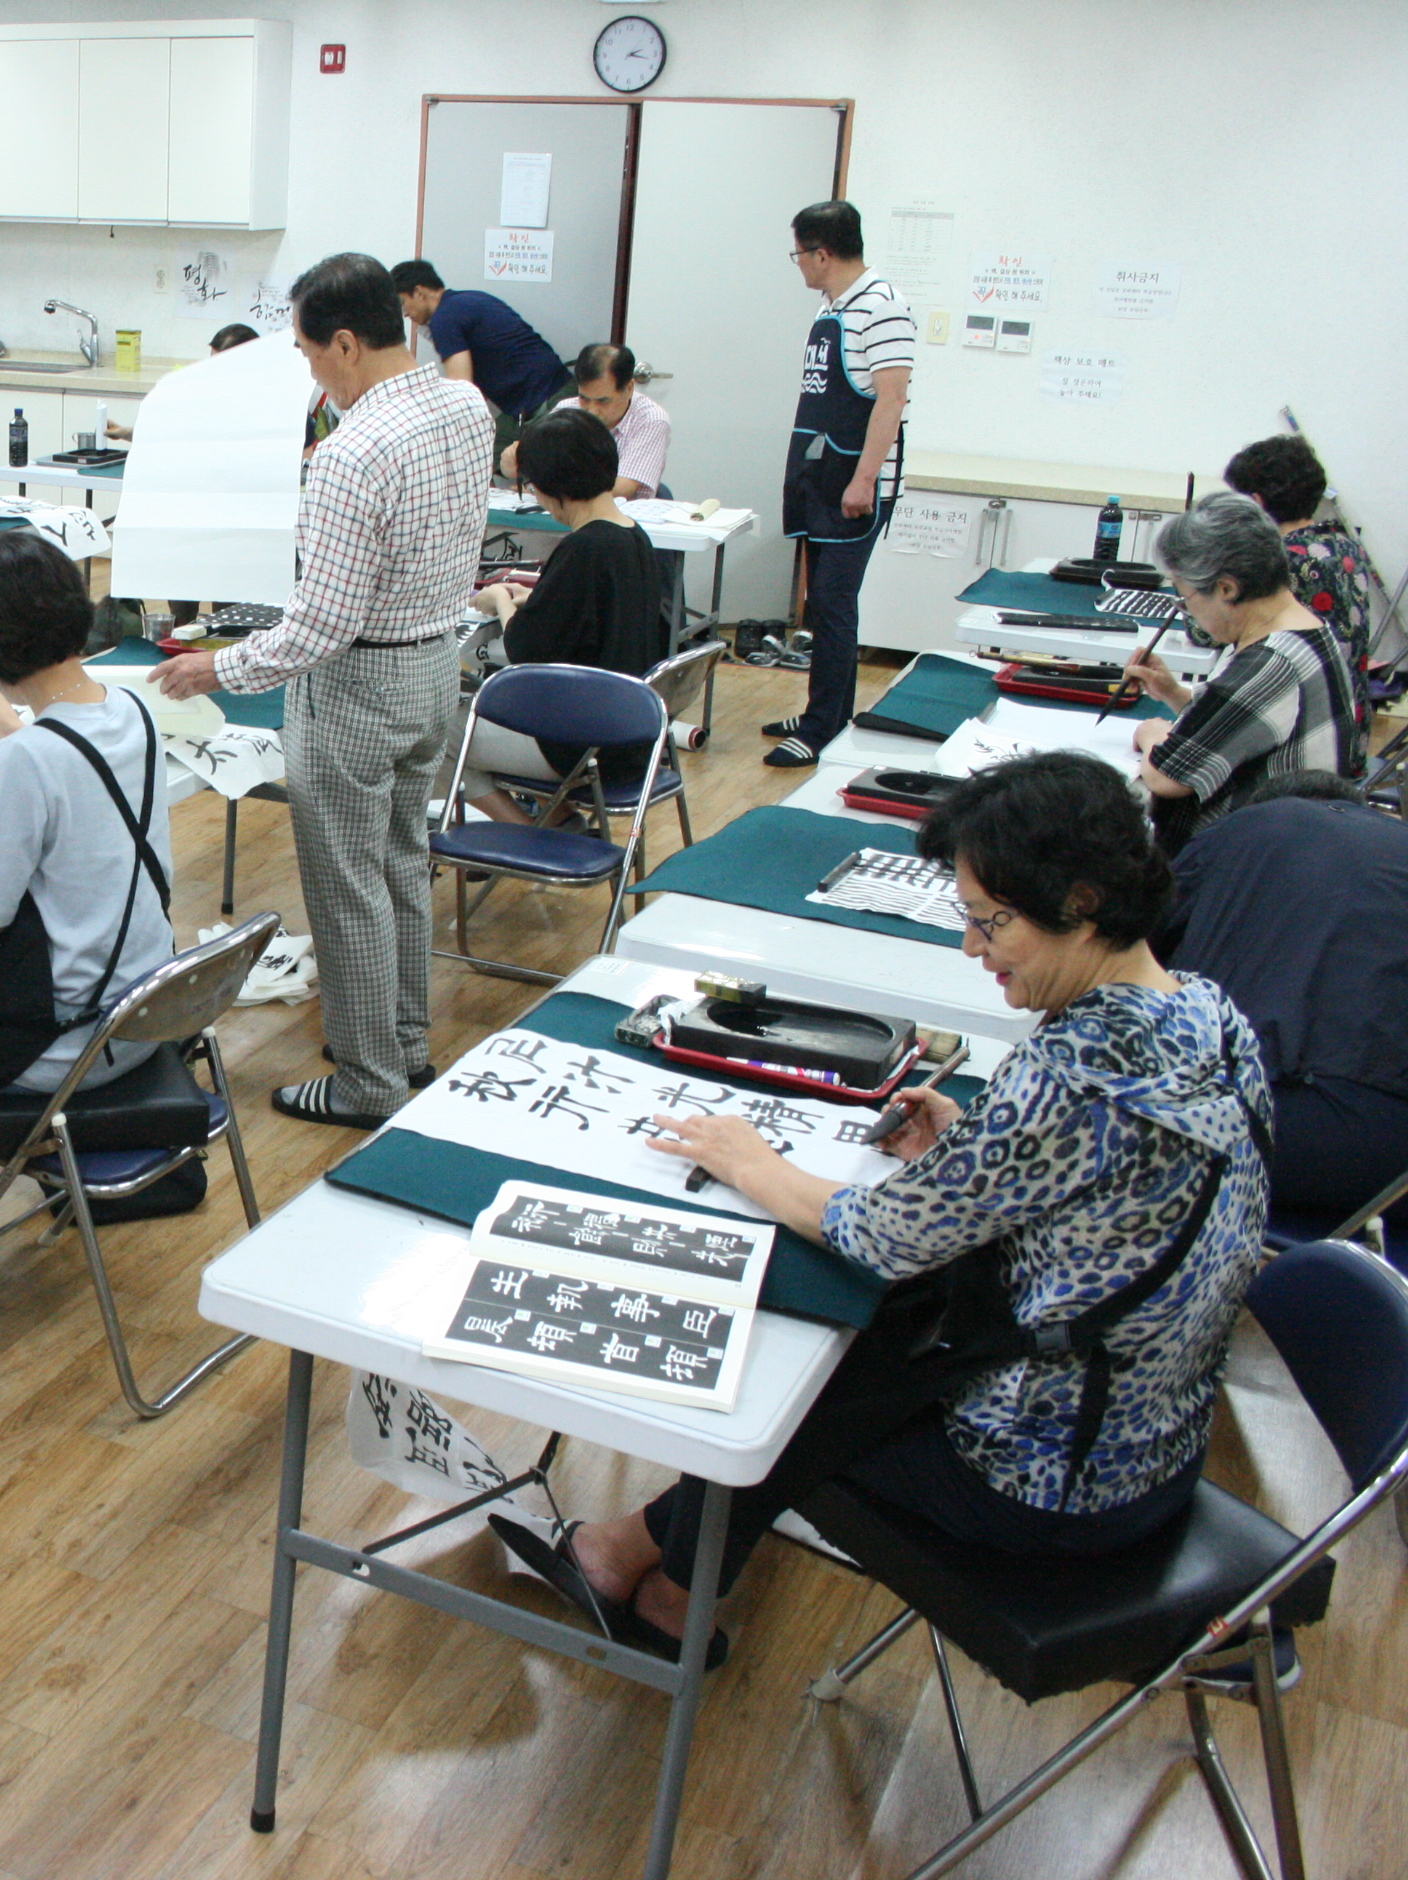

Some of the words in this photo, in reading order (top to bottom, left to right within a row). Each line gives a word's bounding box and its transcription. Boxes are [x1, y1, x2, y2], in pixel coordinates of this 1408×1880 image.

[182, 264, 228, 302] 평화
[1115, 271, 1159, 284] 취사금지
[893, 506, 914, 519] 무단
[919, 509, 941, 521] 사용
[946, 511, 967, 524] 금지
